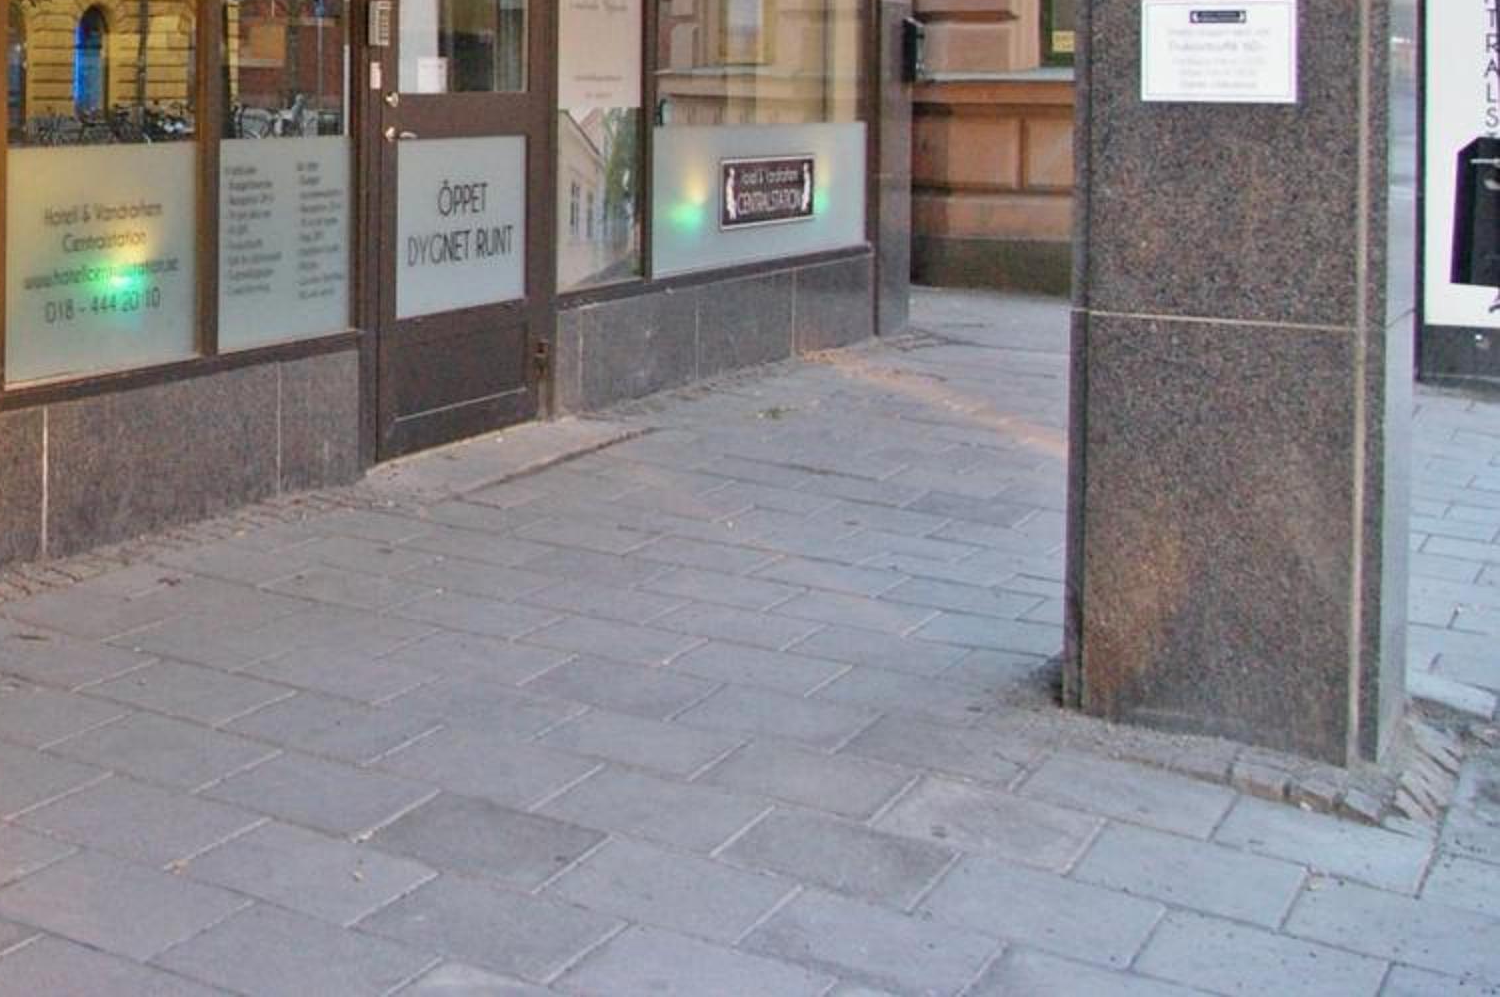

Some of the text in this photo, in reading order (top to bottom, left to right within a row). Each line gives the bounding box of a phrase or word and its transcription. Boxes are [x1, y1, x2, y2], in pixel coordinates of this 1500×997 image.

[437, 180, 489, 217] ÖPPET
[407, 224, 514, 268] DYGNET RUNT
[44, 298, 75, 324] 018
